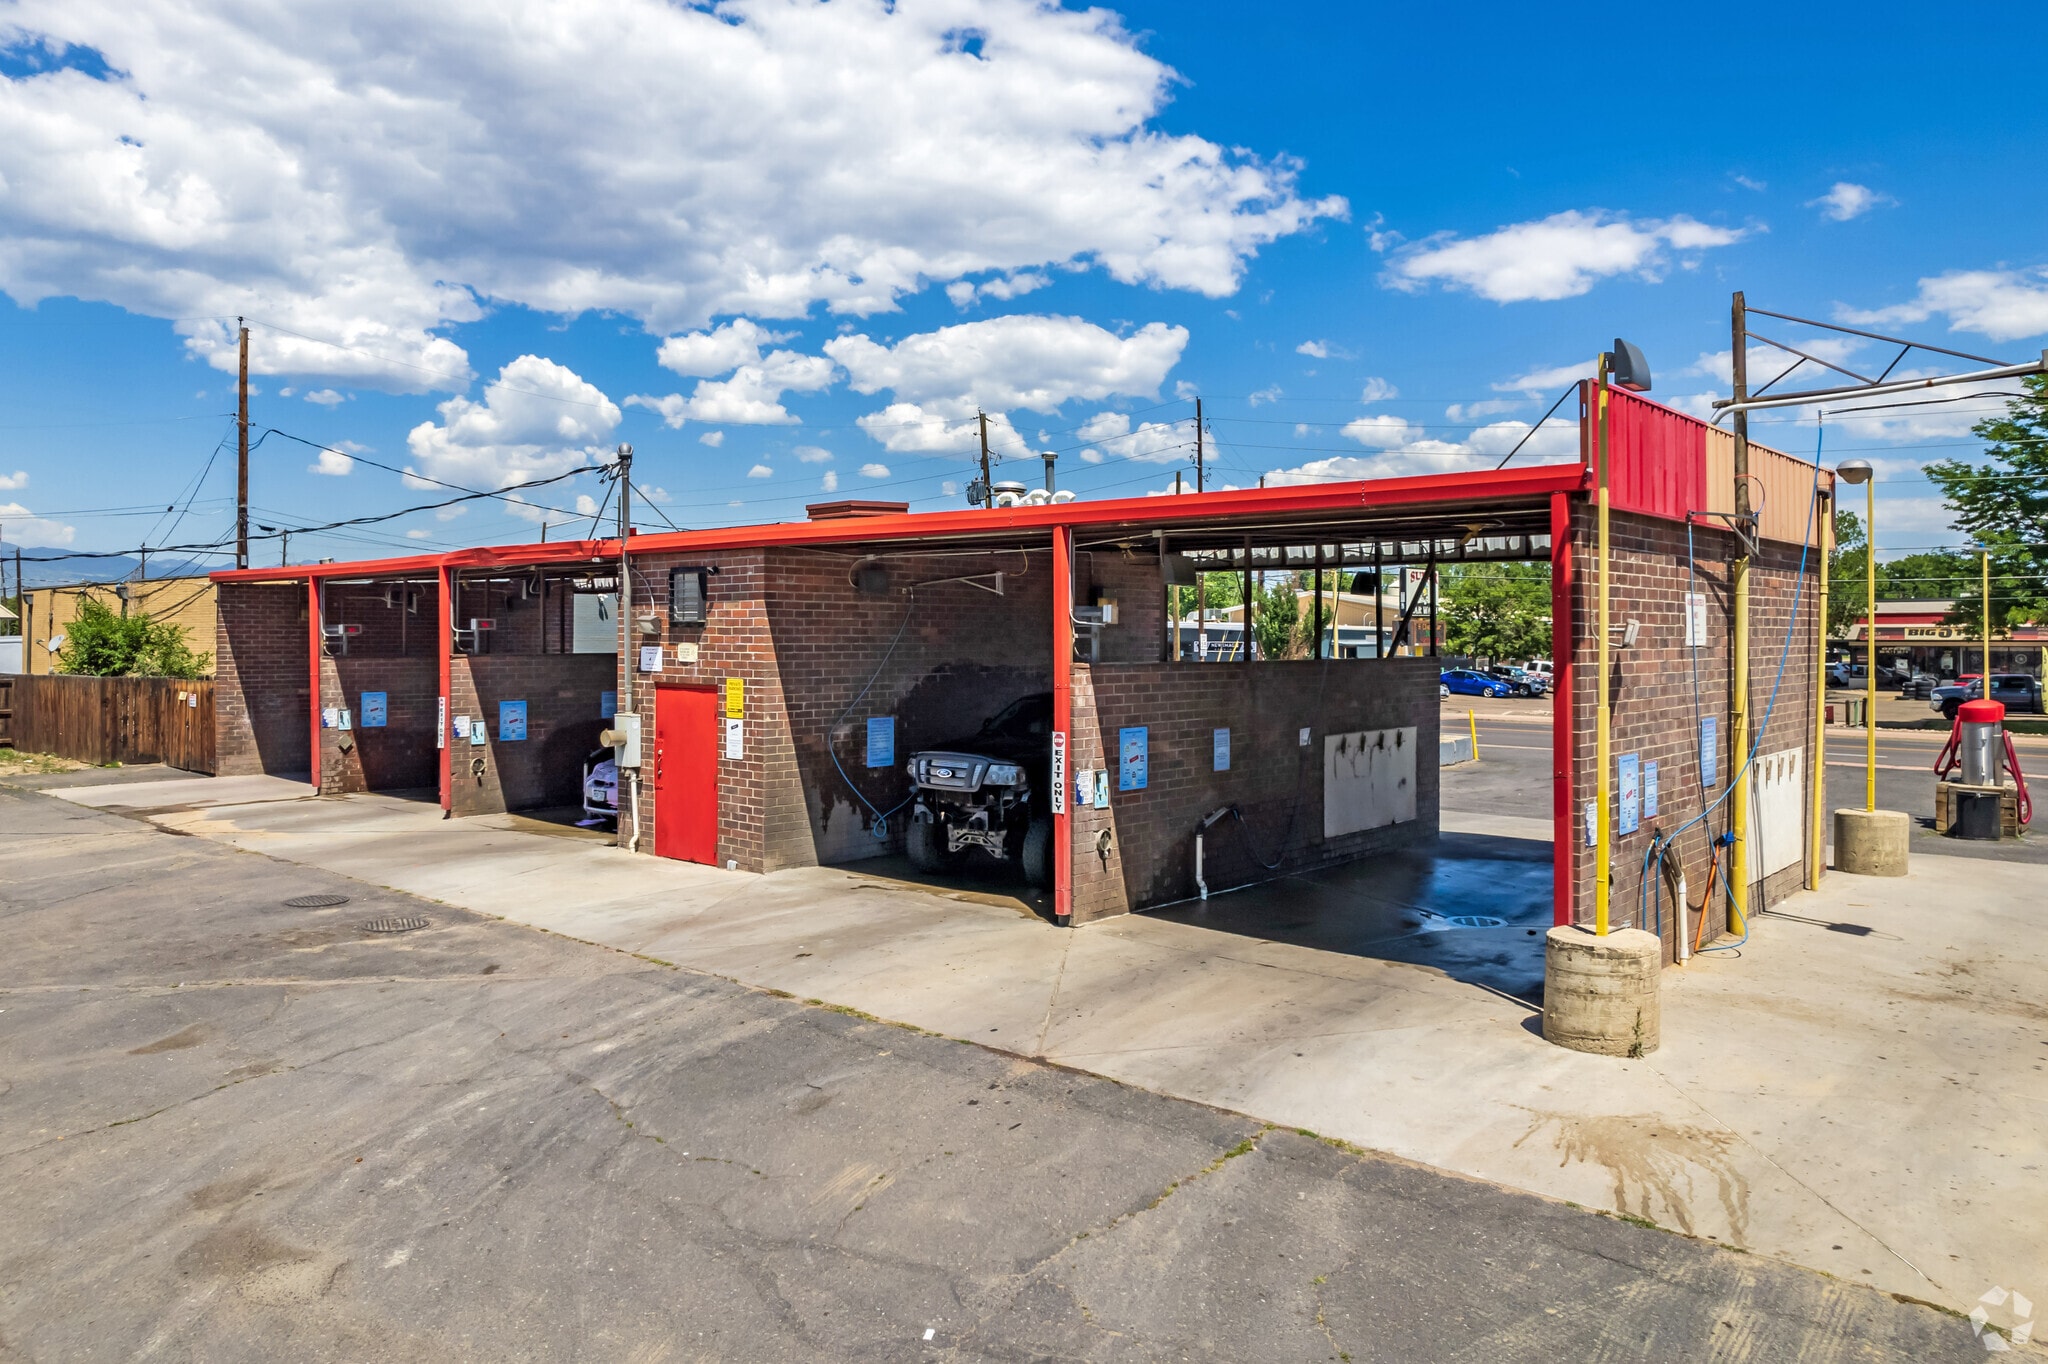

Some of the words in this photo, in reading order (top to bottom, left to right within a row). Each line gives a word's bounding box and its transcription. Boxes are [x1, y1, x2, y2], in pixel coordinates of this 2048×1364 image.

[1908, 628, 1936, 636] BIG
[1054, 750, 1063, 778] EXIT
[1054, 782, 1063, 811] ONLY
